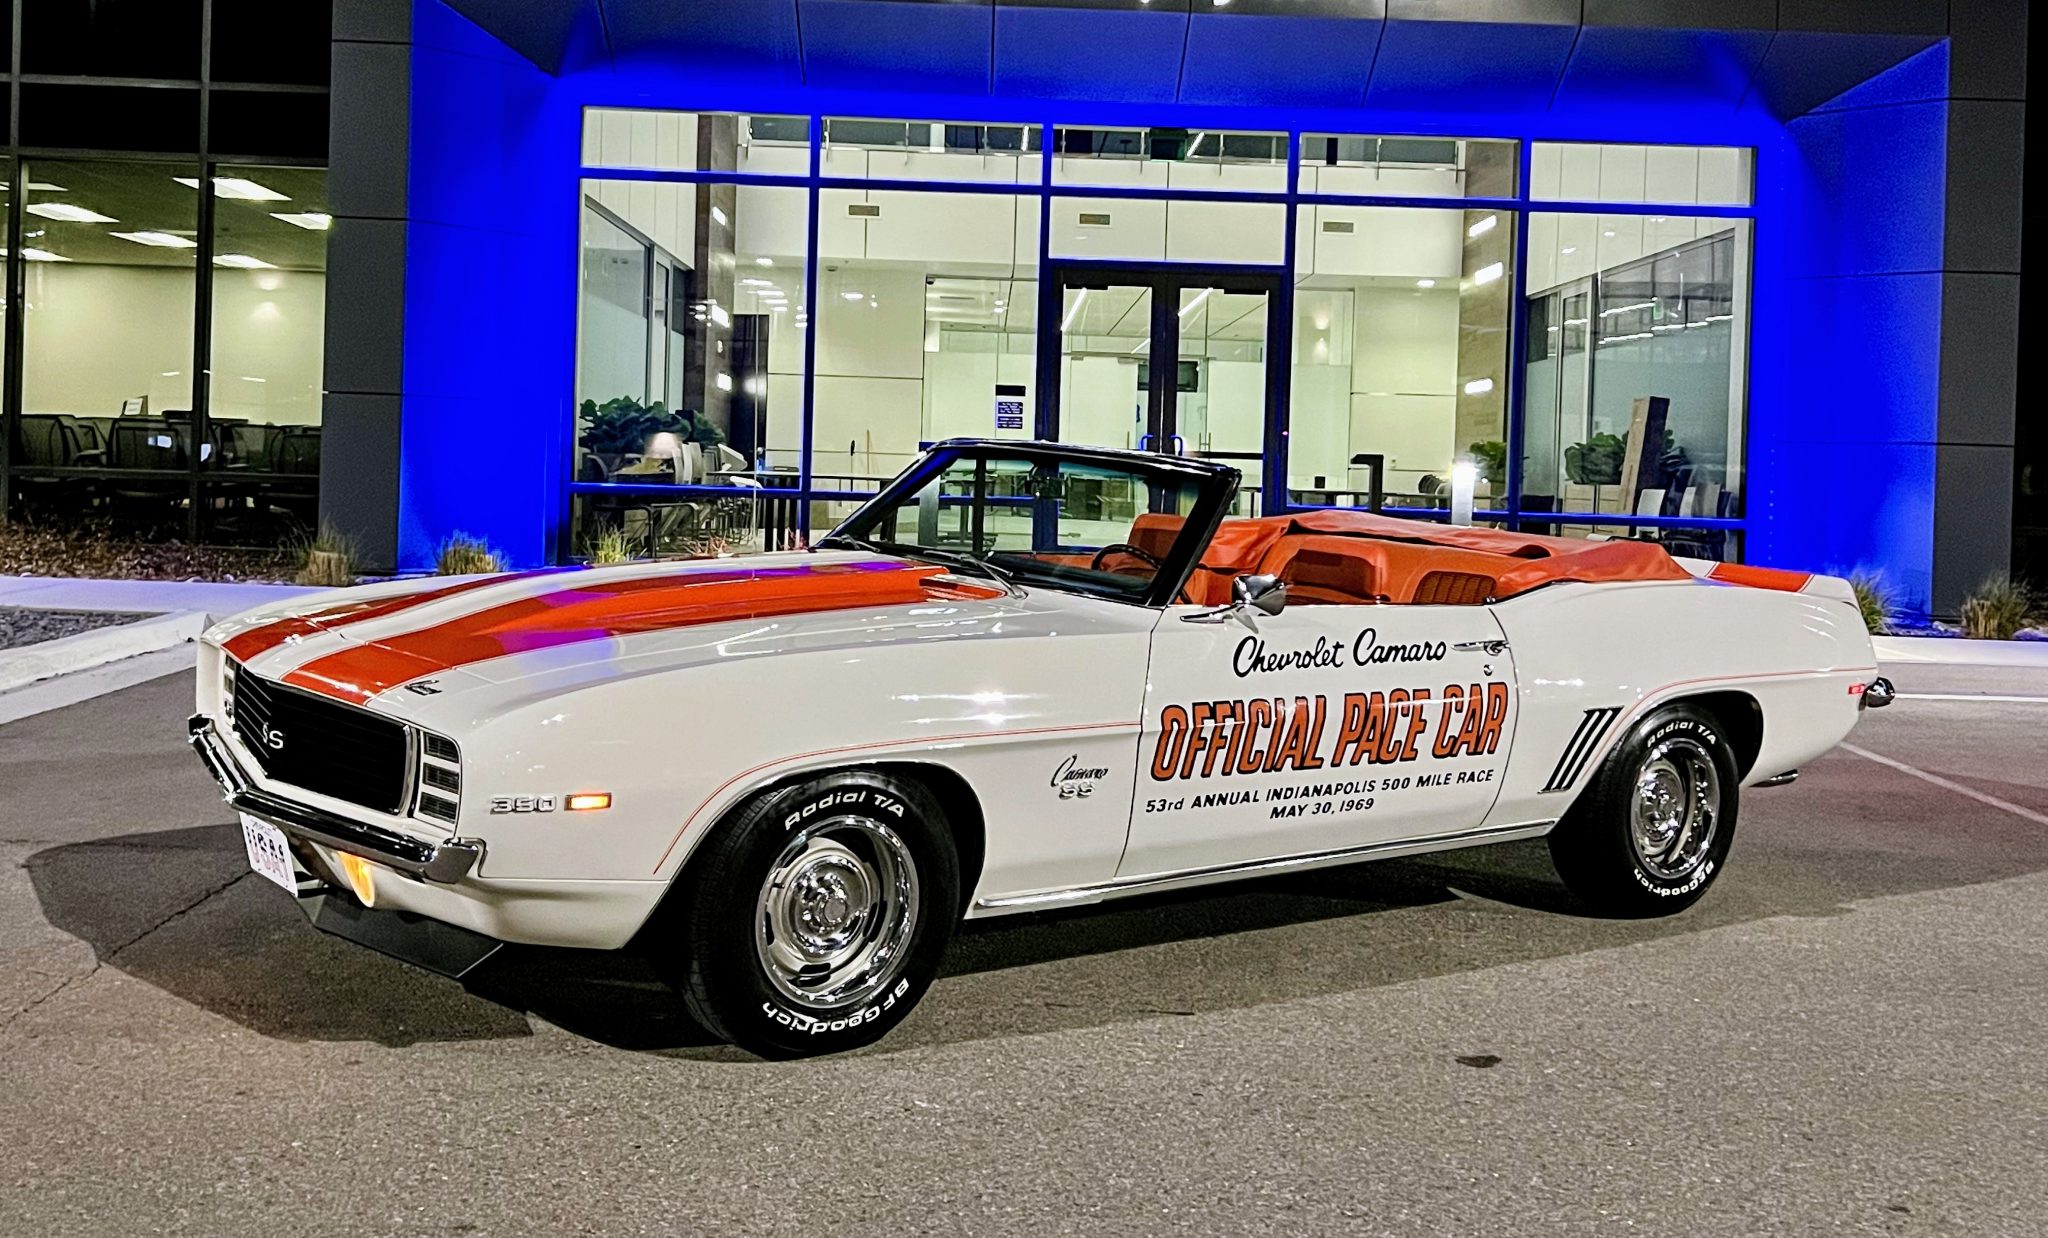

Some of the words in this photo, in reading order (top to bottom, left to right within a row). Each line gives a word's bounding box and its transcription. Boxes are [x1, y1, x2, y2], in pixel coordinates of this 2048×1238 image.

[1233, 636, 1344, 677] Chevrolet
[1353, 628, 1446, 666] Camaro
[1150, 695, 1326, 781] OFFICIAL
[1332, 688, 1430, 766] PACE
[1432, 681, 1509, 758] CAR
[1647, 720, 1693, 747] Radial
[1698, 724, 1717, 745] T/A
[1051, 754, 1108, 787] Camaro
[490, 793, 557, 815] 350
[785, 791, 867, 830] Radial
[874, 794, 904, 817] T/A
[1145, 798, 1184, 813] 53rd
[1191, 790, 1260, 808] ANNUAL
[1265, 780, 1376, 801] INDIANAPOLIS
[1381, 777, 1410, 791] 500
[1416, 773, 1452, 787] MILE
[1456, 769, 1494, 784] RACE
[1270, 804, 1308, 819] MAY
[1311, 802, 1335, 815] 30,
[1339, 798, 1374, 812] 1969
[763, 978, 909, 1035] BFGoodrich
